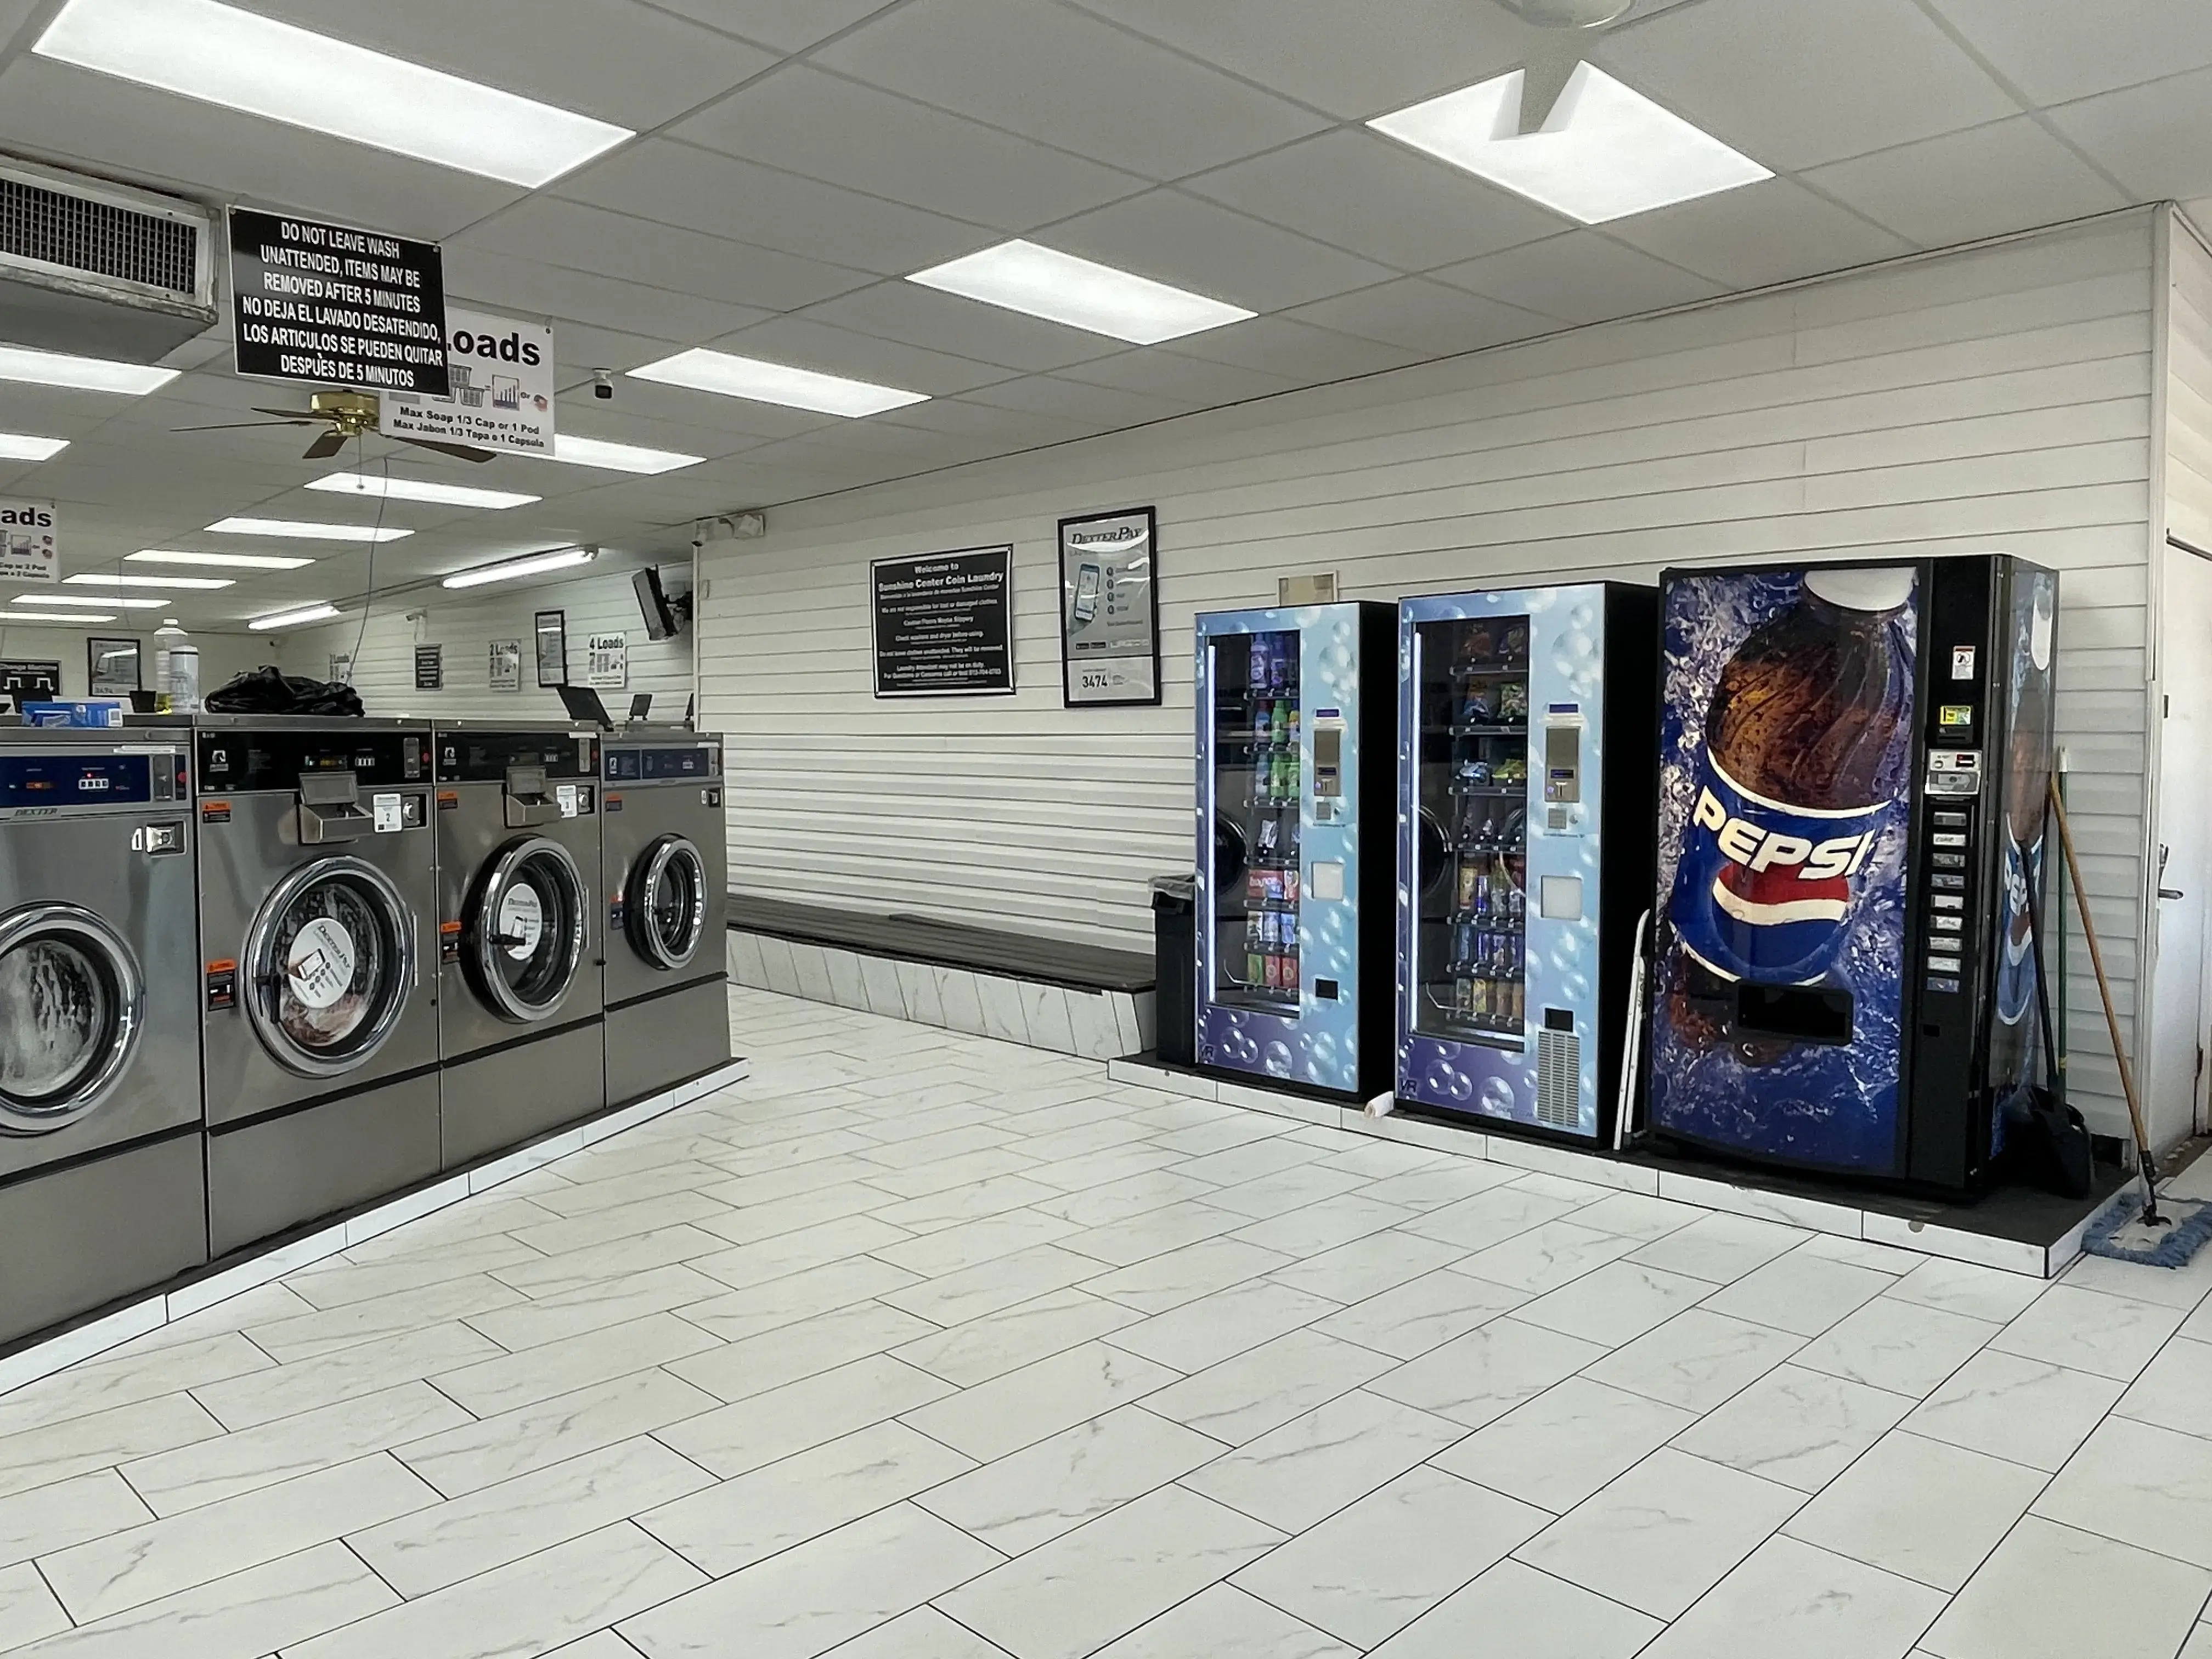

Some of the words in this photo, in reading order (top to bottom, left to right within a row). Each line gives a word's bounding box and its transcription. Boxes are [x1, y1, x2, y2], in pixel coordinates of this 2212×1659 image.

[281, 222, 300, 241] DO
[302, 225, 326, 245] NOT
[329, 230, 365, 253] LEAVE
[366, 237, 399, 259] WASH
[261, 244, 343, 278] UNATTENDED,
[345, 258, 379, 280] ITEMS
[381, 264, 403, 285] MAY
[405, 269, 420, 288] BE
[263, 271, 323, 297] REMOVED
[325, 281, 363, 304] AFTER
[364, 287, 371, 305] 5
[373, 289, 421, 313] MINUTES
[242, 296, 261, 315] NO
[263, 299, 296, 320] DEJA
[297, 304, 314, 323] EL
[315, 306, 361, 329] LAVADO
[363, 313, 441, 344] DESATENDIDO,
[243, 323, 269, 343] LOS
[271, 327, 338, 352] ARTICULOS
[340, 336, 356, 354] SE
[358, 338, 403, 360] PUEDEN
[404, 345, 443, 366] QUITAR
[447, 330, 540, 366] oads
[338, 361, 354, 380] DE
[357, 364, 363, 381] 5
[365, 365, 415, 387] MINUTOS
[393, 419, 414, 430] Max
[500, 434, 505, 442] 1
[399, 407, 423, 418] Max
[426, 410, 453, 424] Soap
[457, 415, 472, 425] 1/3
[475, 417, 495, 430] Cap
[521, 424, 540, 435] Pod
[915, 577, 944, 588] Center
[946, 575, 966, 585] Coin
[967, 572, 1004, 583] Laundry
[950, 562, 959, 571] to
[589, 637, 595, 649] 4
[597, 635, 623, 649] Loads
[1081, 674, 1109, 689] 3474
[1693, 785, 1876, 879] PEPSI
